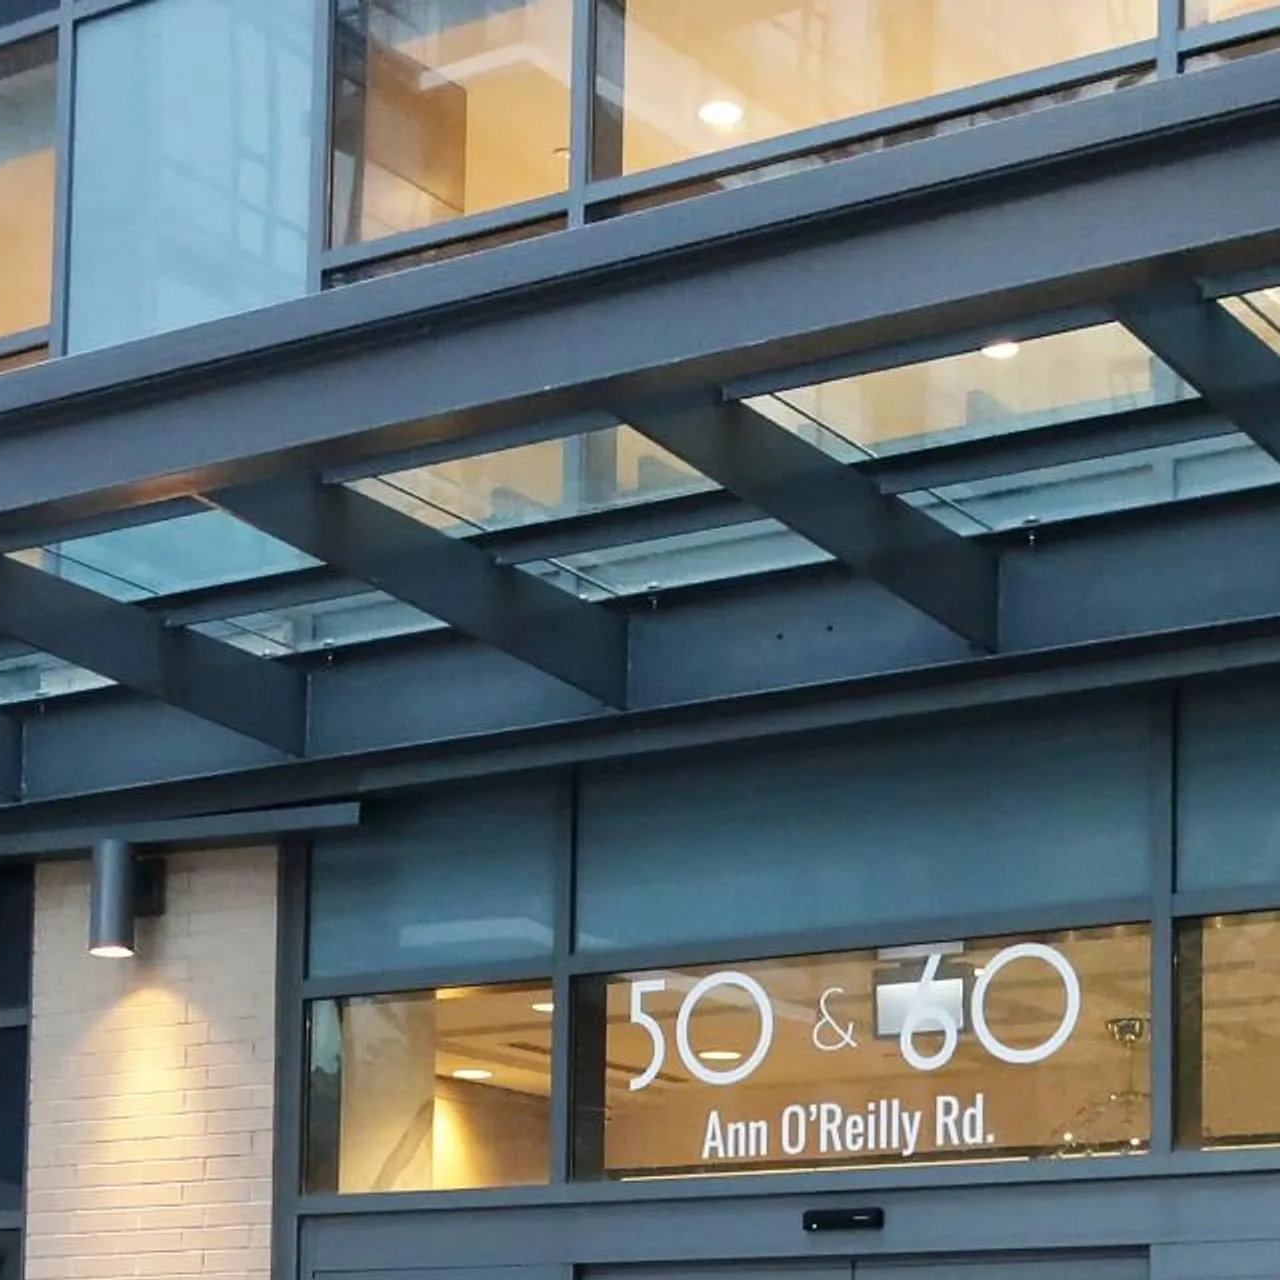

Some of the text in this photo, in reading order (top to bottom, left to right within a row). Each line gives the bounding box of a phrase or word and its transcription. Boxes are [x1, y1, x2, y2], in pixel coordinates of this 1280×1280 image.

[628, 942, 1080, 1091] 50 & 60
[702, 1093, 995, 1160] Ann O'Reilly Rd.
